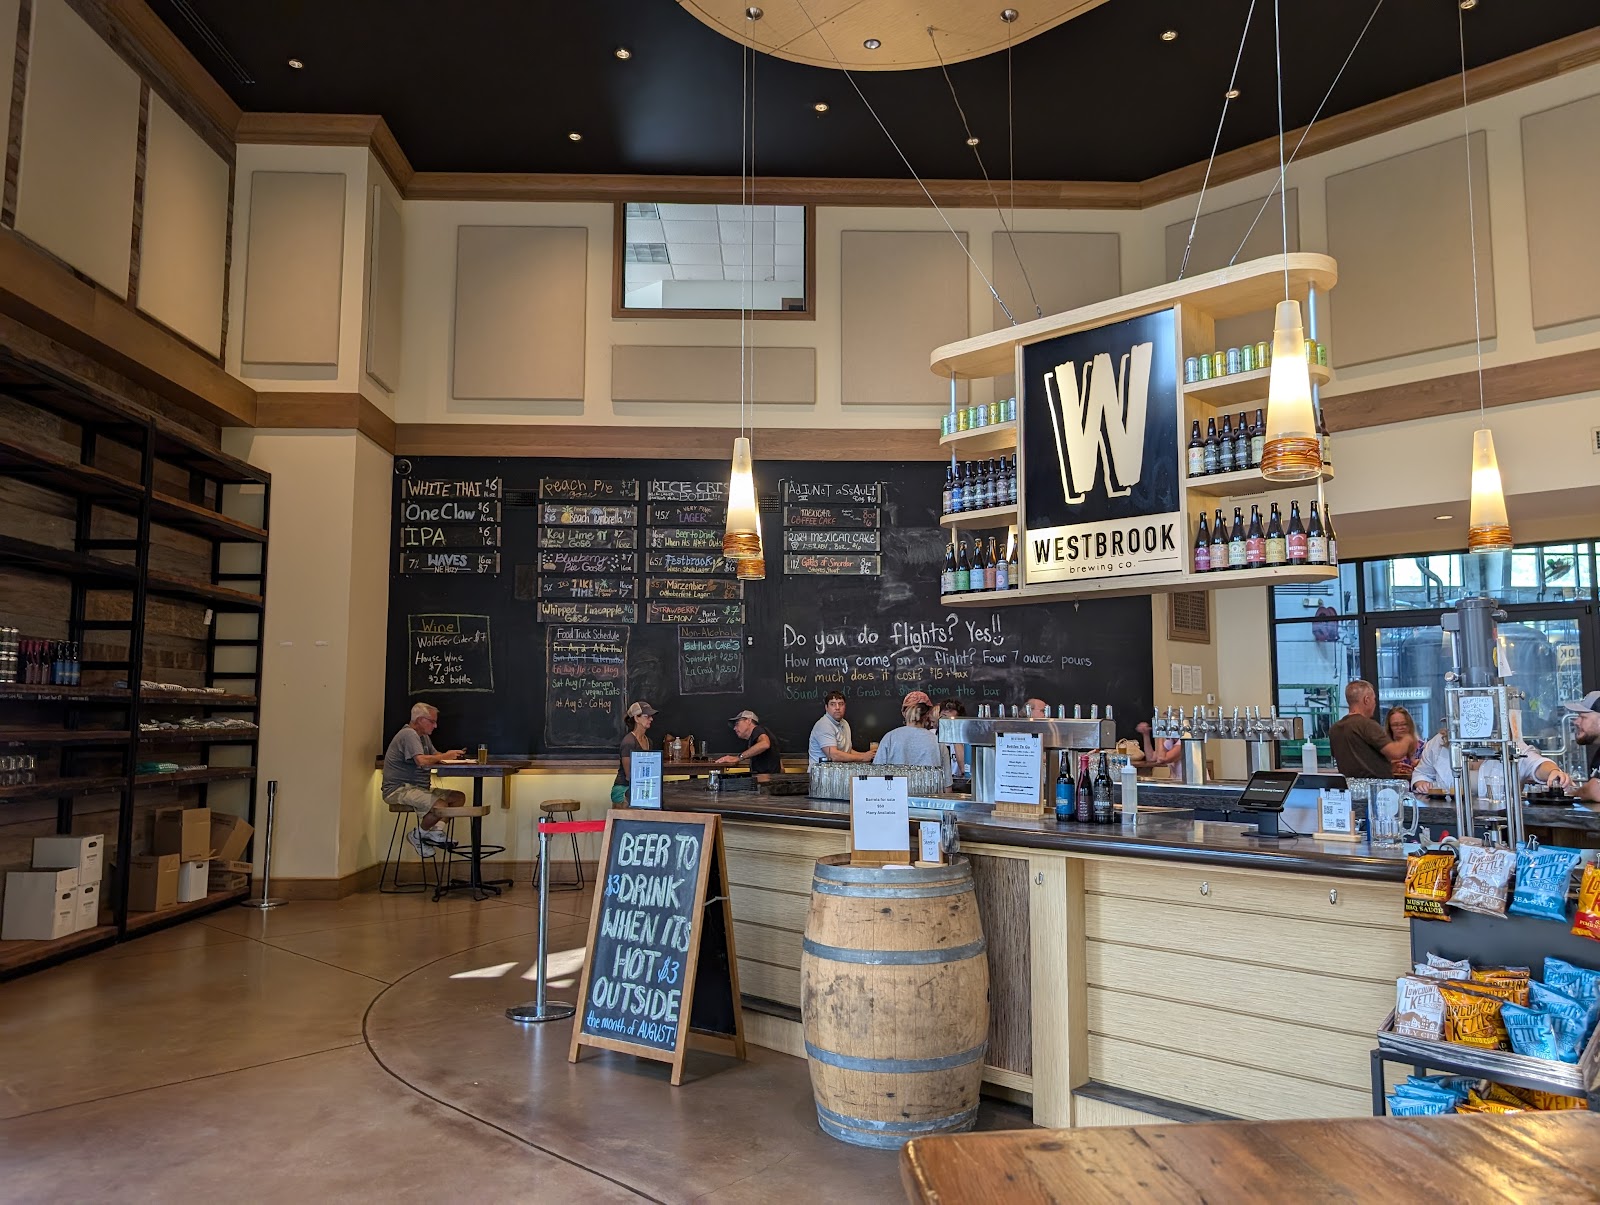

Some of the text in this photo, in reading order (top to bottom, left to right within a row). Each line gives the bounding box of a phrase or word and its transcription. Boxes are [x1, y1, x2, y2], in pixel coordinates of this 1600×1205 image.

[408, 480, 482, 497] WHITE THAI
[653, 480, 693, 494] RICE
[679, 513, 708, 523] LAGER
[405, 527, 447, 546] IPA
[547, 529, 565, 544] Key
[568, 530, 595, 541] Lime
[810, 532, 853, 544] MEXICAN
[852, 532, 878, 544] CAKE
[1034, 523, 1176, 564] WESTBROOK
[427, 554, 468, 567] WAVES
[555, 553, 609, 568] Blueberry
[664, 554, 714, 568] Festbrook
[1069, 558, 1114, 574] brewing
[570, 588, 595, 598] TIME
[421, 618, 455, 633] Wine
[661, 613, 694, 623] LEMON
[557, 628, 620, 641] Food Truck Schedule
[783, 623, 807, 648] Do
[814, 629, 847, 654] you
[857, 624, 880, 645] do
[889, 613, 959, 654] flights?
[414, 651, 442, 665] House
[785, 647, 1093, 675] How many come on a flight? Four 7 ounce pours
[785, 671, 808, 684] How
[815, 669, 845, 684] much
[851, 669, 876, 682] does
[881, 667, 892, 681] it
[896, 667, 924, 681] cost?
[929, 667, 945, 680] $15
[784, 684, 1001, 701] Sound Grab a from the bar
[617, 832, 699, 871] BEER TO
[1516, 863, 1569, 888] KETTLE
[605, 873, 685, 911] $3 DRINK
[1513, 895, 1528, 904] SEA
[1406, 898, 1441, 908] MUSTARD
[1419, 906, 1444, 914] SAUCE
[600, 907, 660, 947] WHEN
[612, 943, 680, 985] HOT $3
[591, 975, 682, 1023] OUTSIDE
[1410, 990, 1443, 1011] KETTLE
[586, 1010, 679, 1047] the month of AUGUST!
